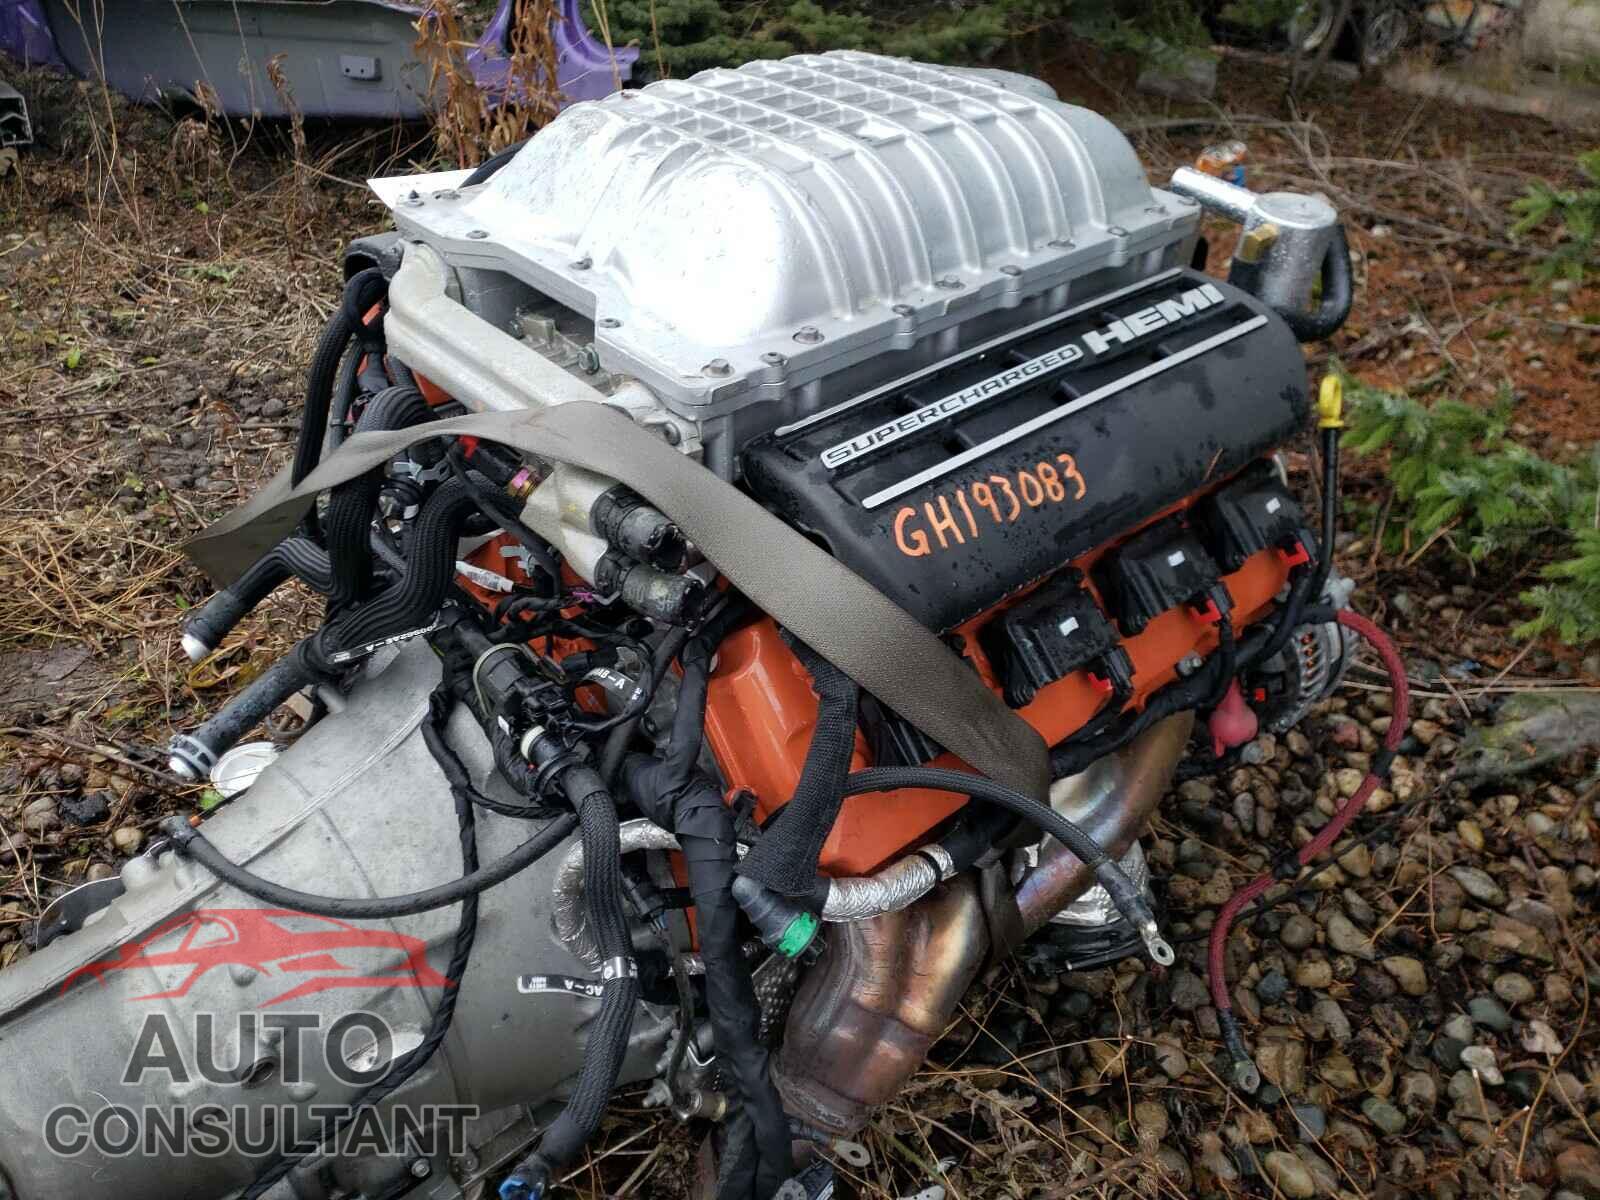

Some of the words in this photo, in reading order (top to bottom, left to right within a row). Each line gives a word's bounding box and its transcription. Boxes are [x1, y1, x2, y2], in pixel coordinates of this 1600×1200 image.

[825, 345, 1079, 464] SUPERCHARGED
[1082, 284, 1225, 356] HEMI
[894, 453, 1087, 558] GH193083
